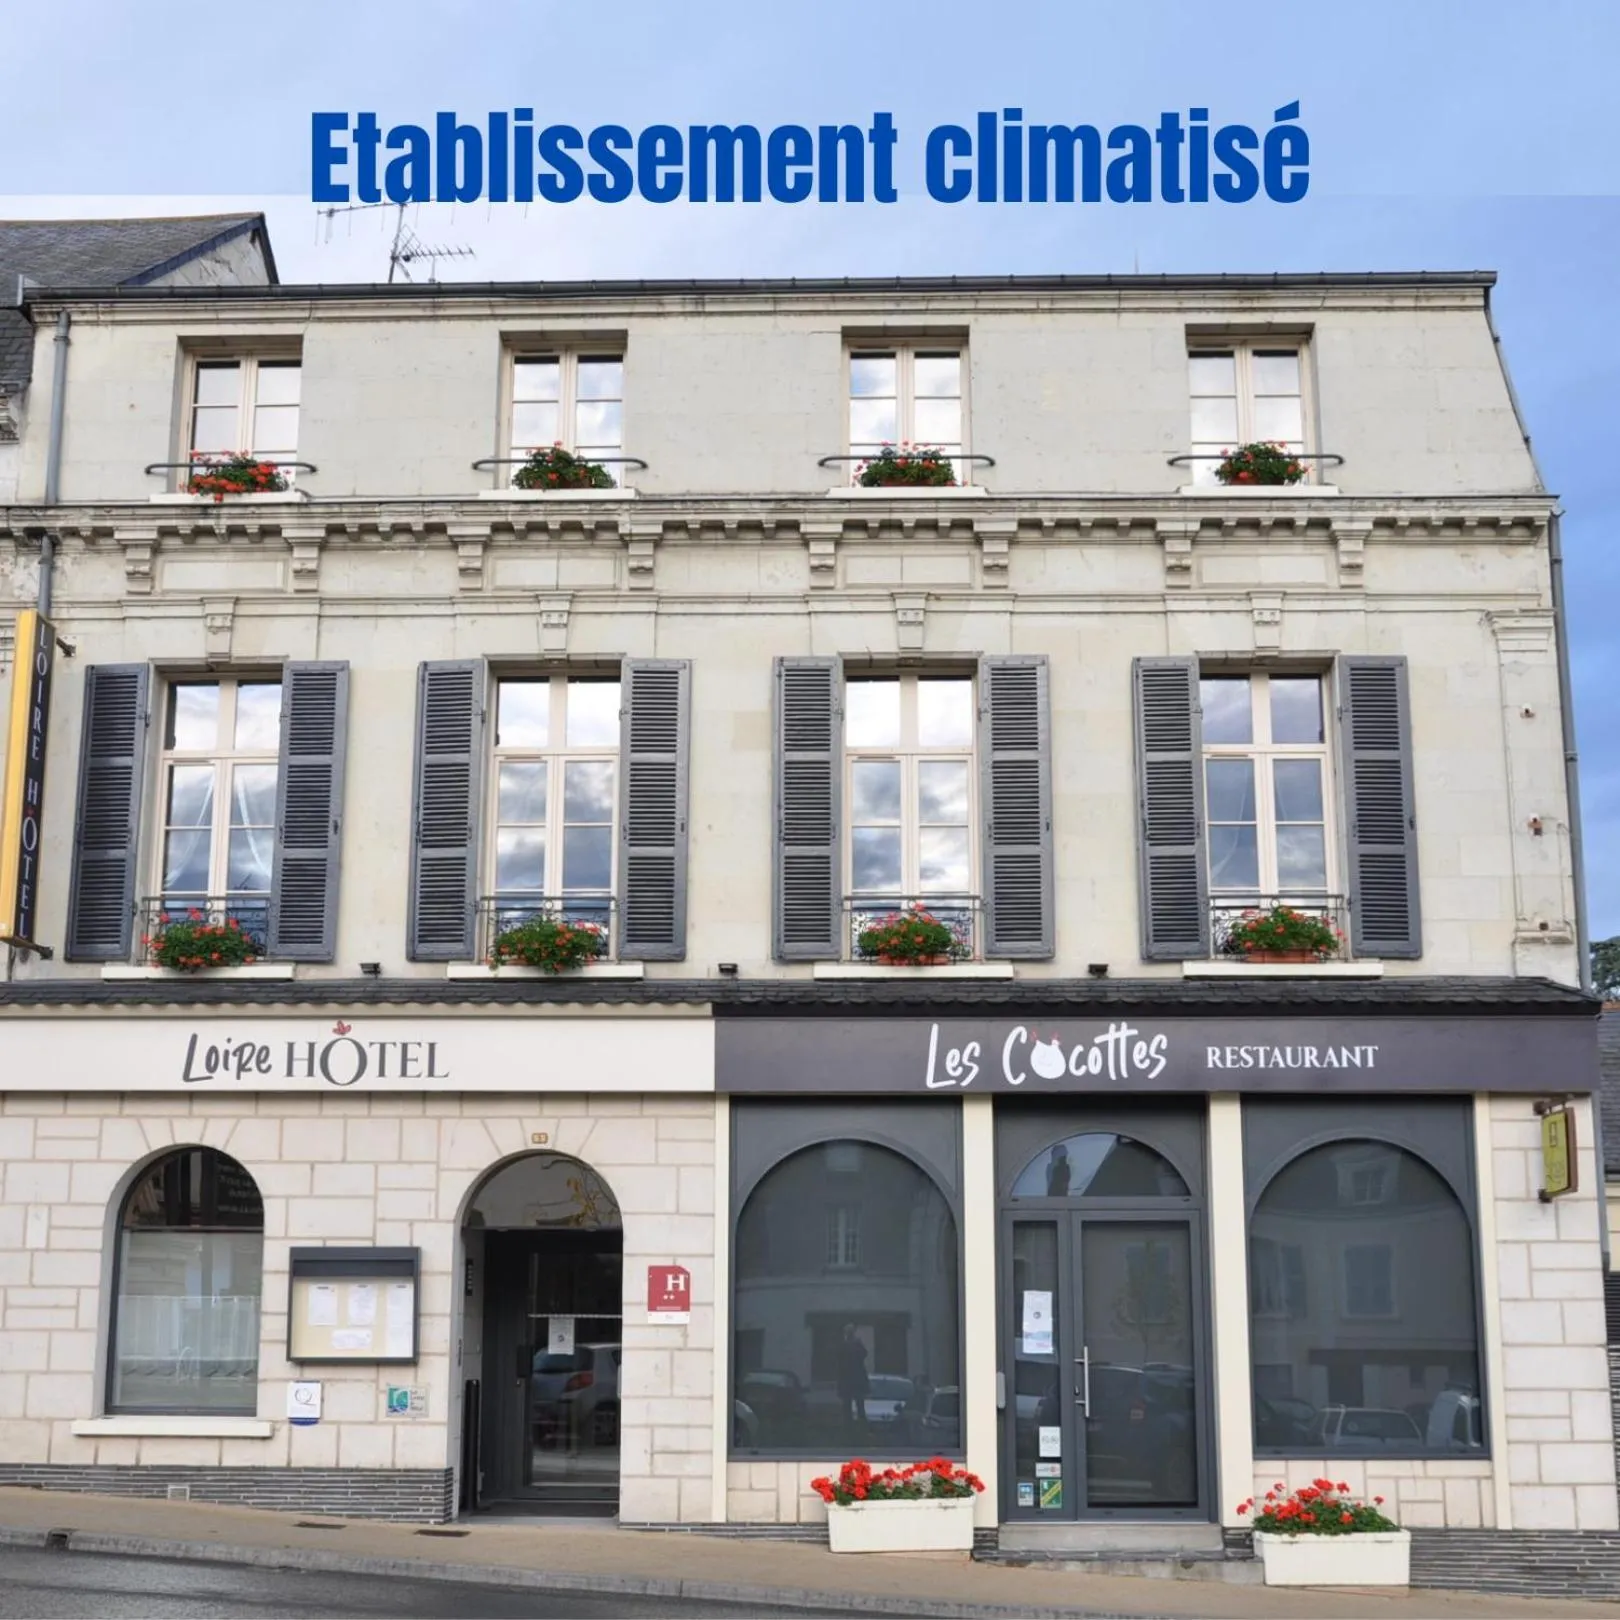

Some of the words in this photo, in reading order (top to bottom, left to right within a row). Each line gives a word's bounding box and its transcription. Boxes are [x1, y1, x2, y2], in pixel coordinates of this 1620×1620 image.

[31, 623, 49, 761] LOIRE
[925, 1022, 981, 1090] Les
[1205, 1045, 1379, 1070] RESTAURANT
[665, 1273, 686, 1292] H
